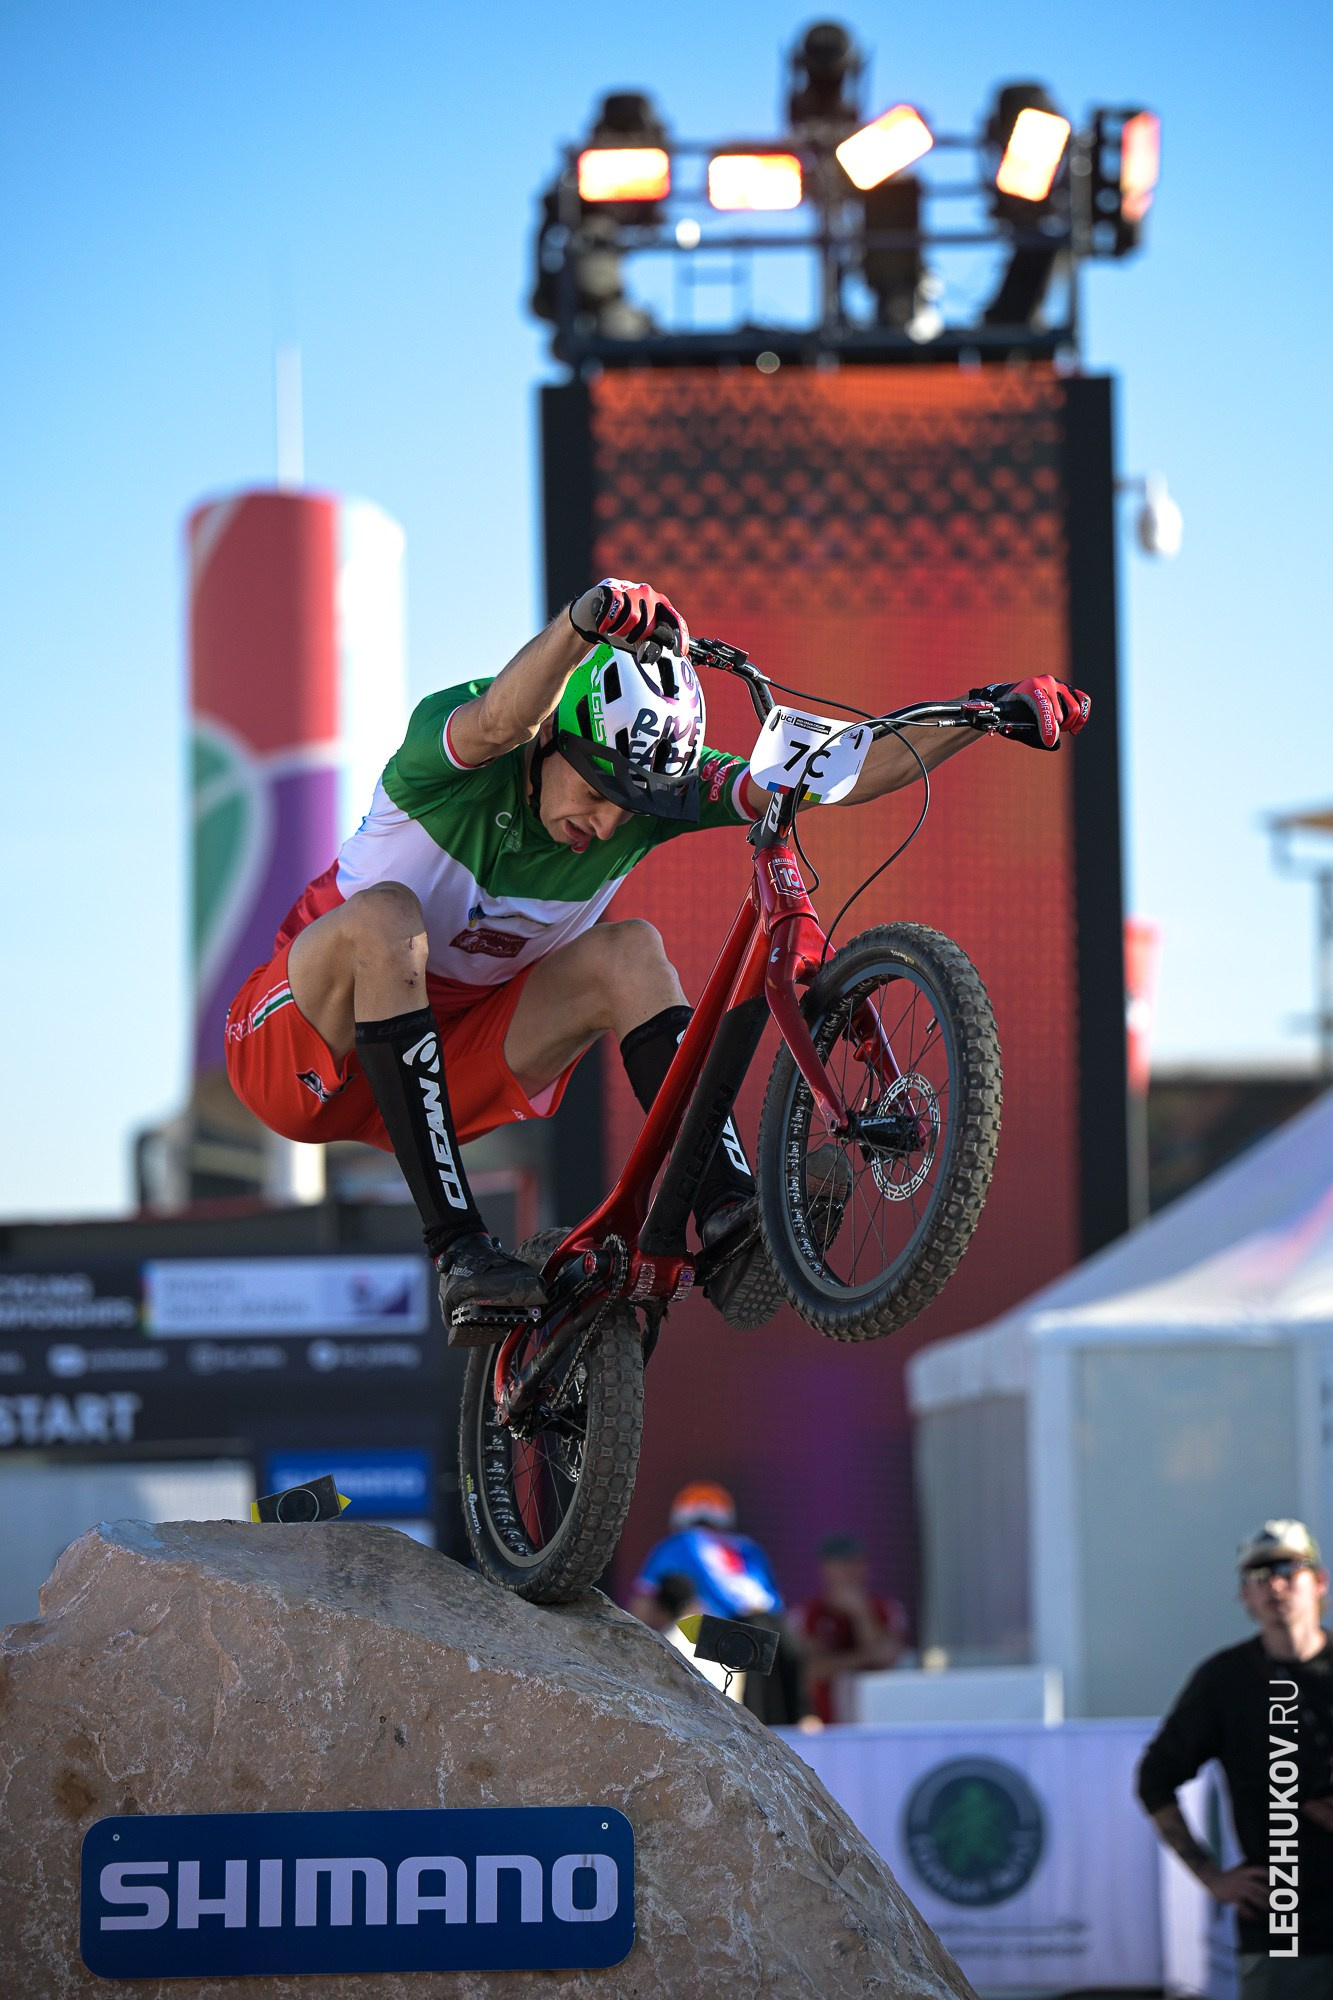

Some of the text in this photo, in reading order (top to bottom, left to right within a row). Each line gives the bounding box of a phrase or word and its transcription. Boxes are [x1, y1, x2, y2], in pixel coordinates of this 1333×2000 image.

[592, 692, 604, 742] GIS
[780, 714, 795, 725] UCI
[1040, 698, 1053, 736] DIFFERENT
[418, 1077, 468, 1210] CLEAN
[861, 1117, 897, 1127] CLEAN
[100, 1853, 619, 1931] SHIMANO
